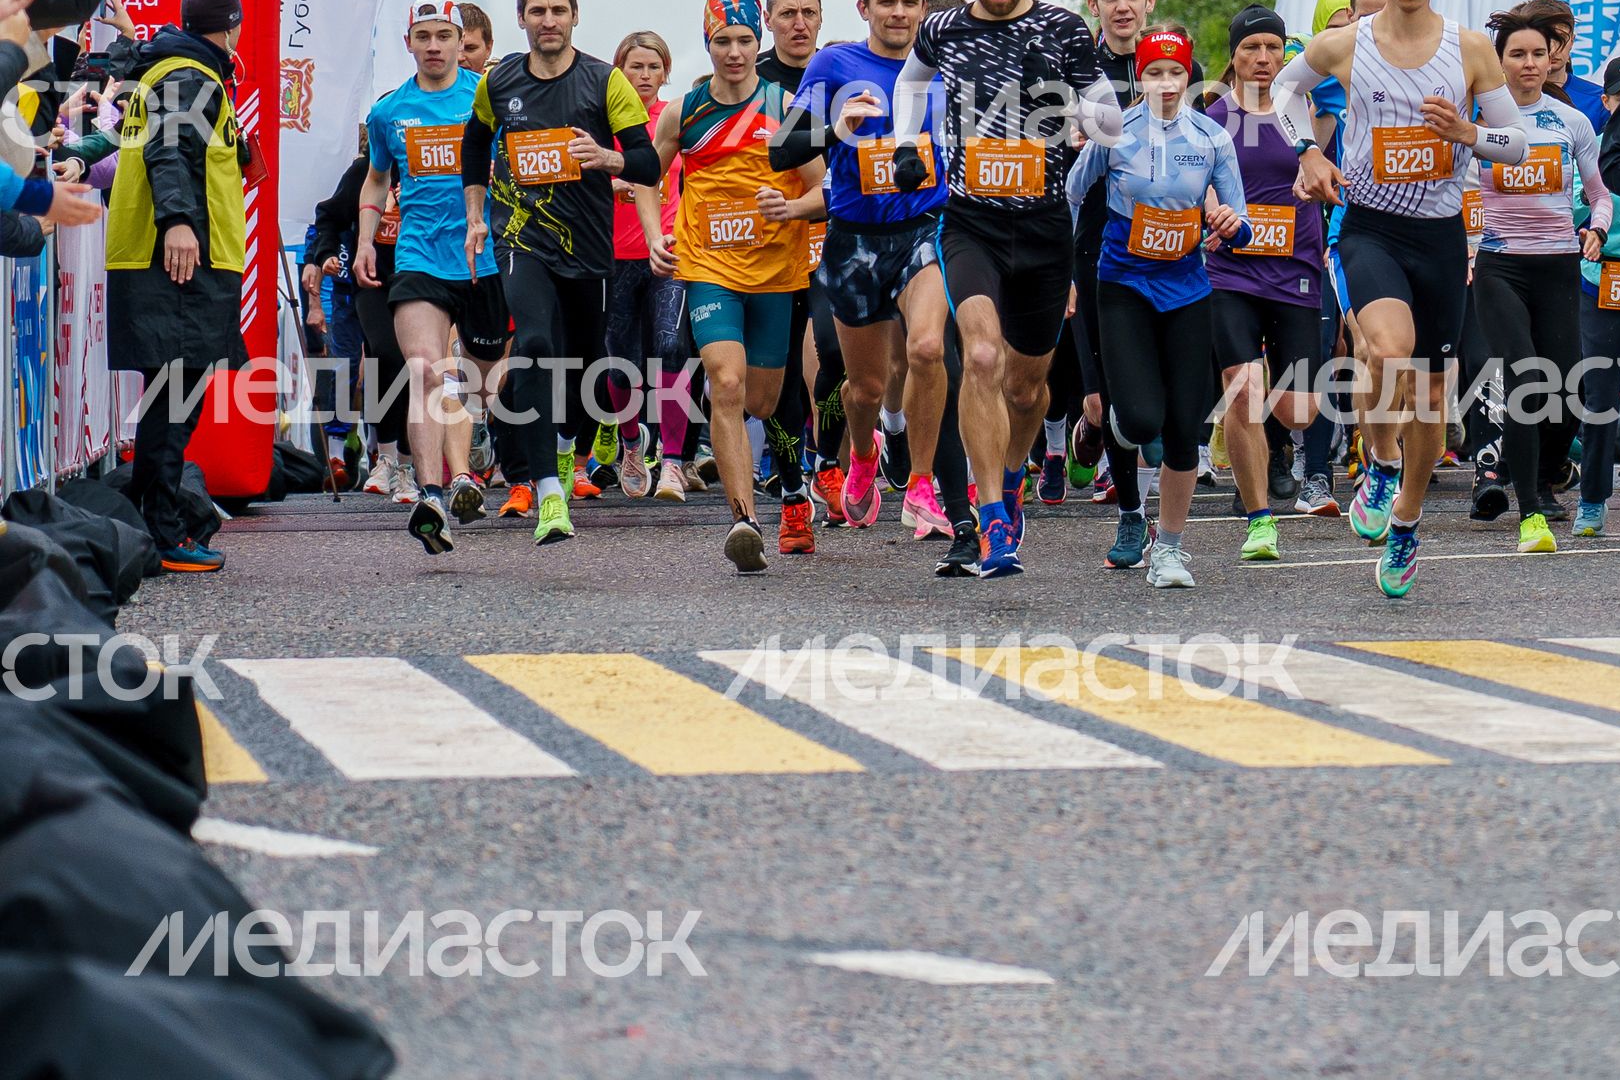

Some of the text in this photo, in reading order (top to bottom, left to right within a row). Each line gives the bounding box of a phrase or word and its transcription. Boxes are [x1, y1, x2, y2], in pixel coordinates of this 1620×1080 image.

[1151, 33, 1184, 47] LUKOIL
[420, 144, 456, 168] 5115
[517, 149, 562, 176] 5263
[1173, 154, 1207, 162] OZERY
[1384, 147, 1435, 174] 5229
[979, 160, 1023, 187] 5071
[1502, 165, 1547, 188] 5264
[709, 218, 755, 244] 5022
[1141, 225, 1186, 252] 5201
